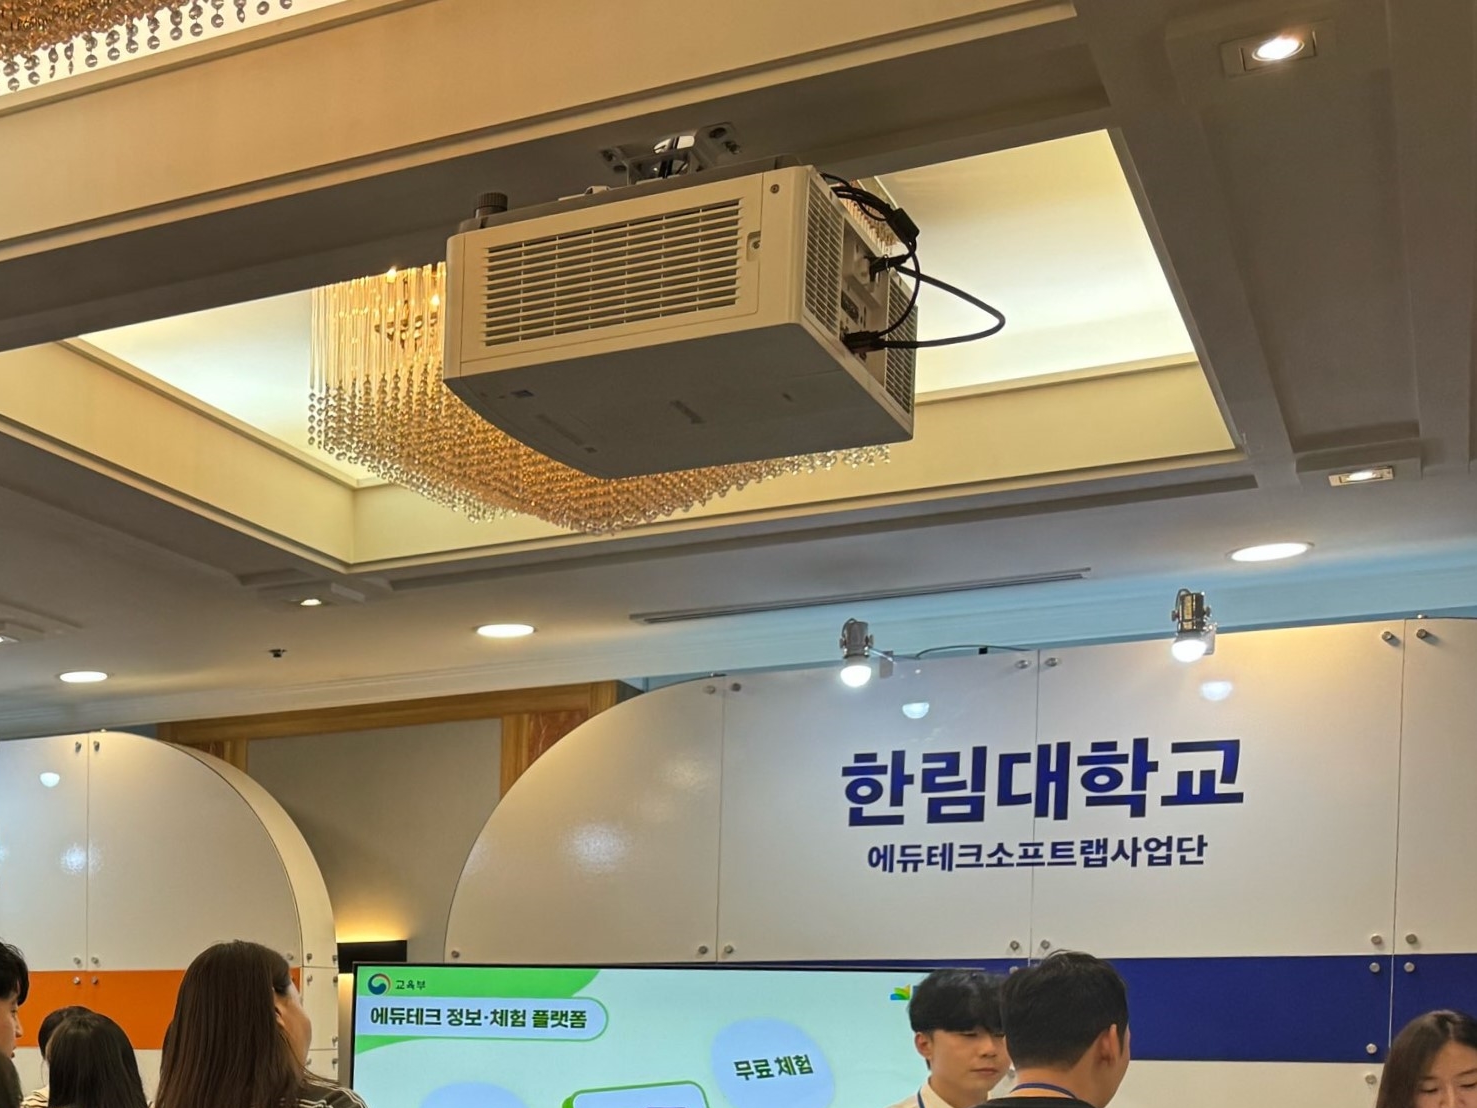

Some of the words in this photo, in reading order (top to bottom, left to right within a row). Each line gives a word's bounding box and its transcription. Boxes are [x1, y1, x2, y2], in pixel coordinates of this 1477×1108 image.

[841, 737, 1244, 827] 한림대학교
[867, 834, 1208, 873] 에듀테크소프트랩사업단
[395, 979, 426, 990] 교육부
[370, 1007, 442, 1026] 에듀테크
[531, 1009, 587, 1029] 플랫폼
[733, 1059, 774, 1081] 무료
[775, 1054, 814, 1077] 체험
